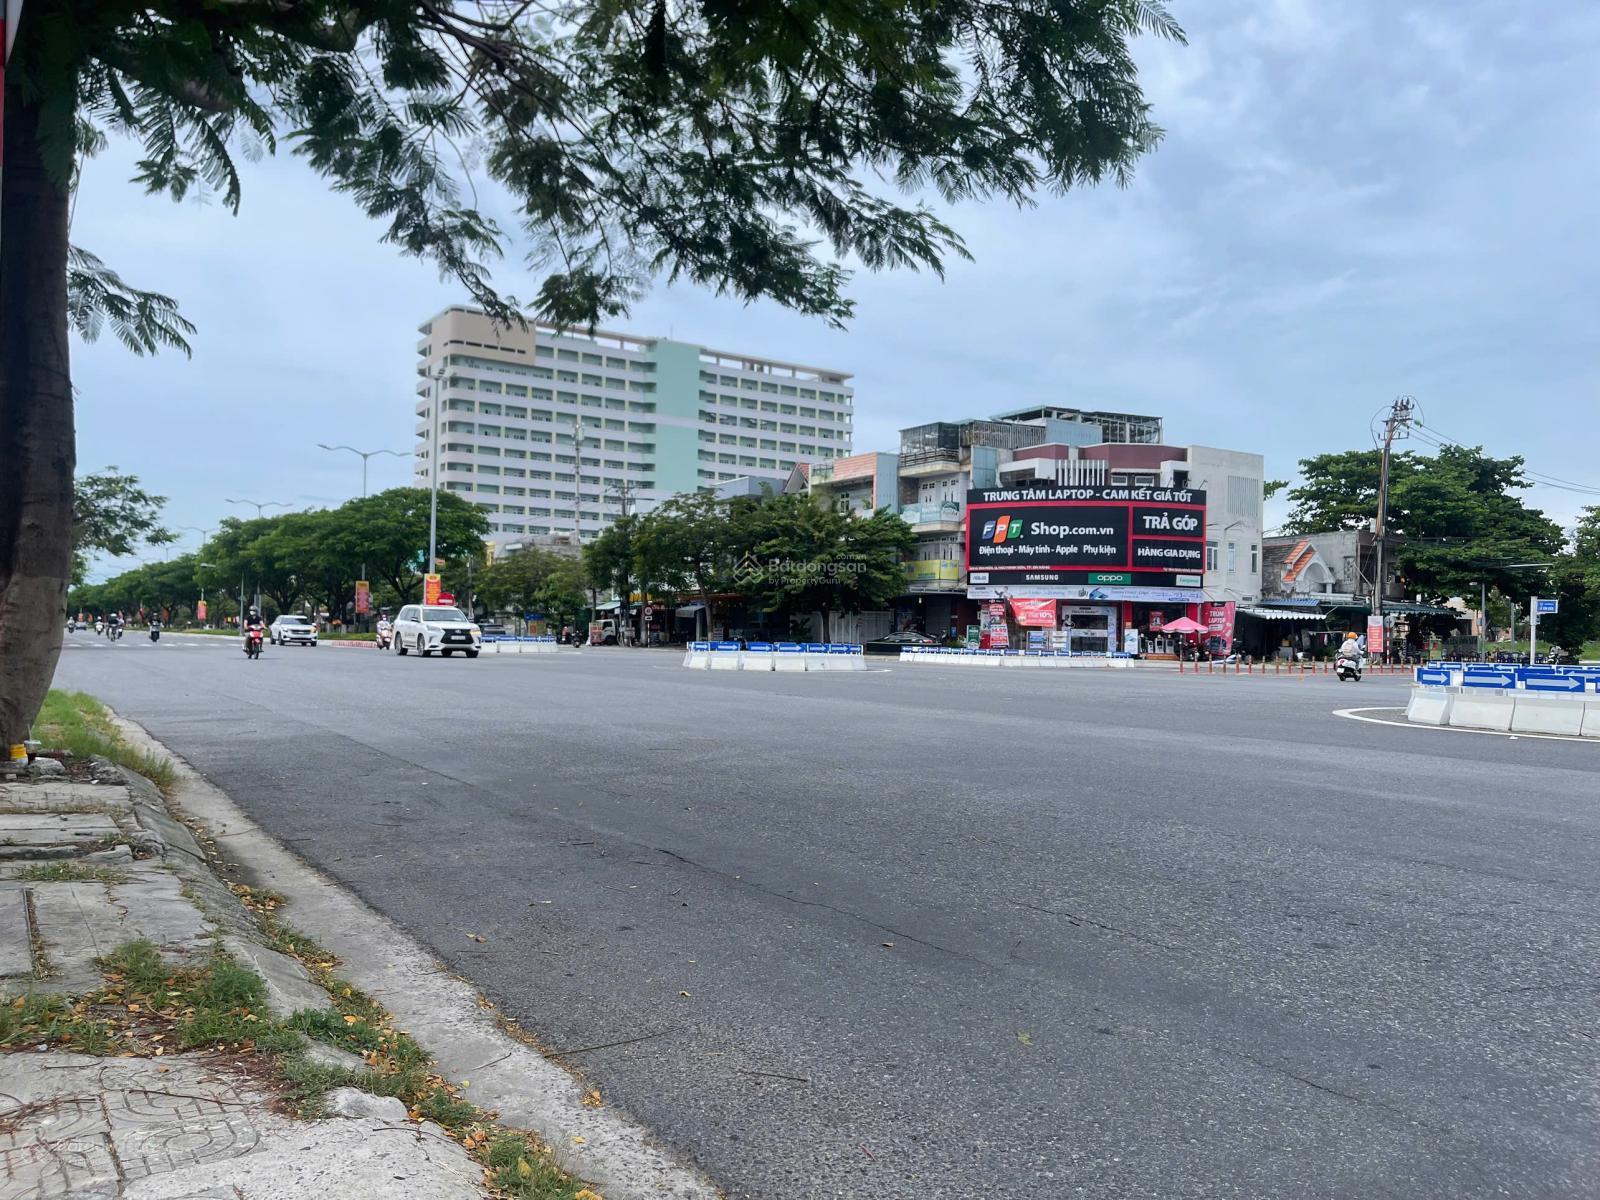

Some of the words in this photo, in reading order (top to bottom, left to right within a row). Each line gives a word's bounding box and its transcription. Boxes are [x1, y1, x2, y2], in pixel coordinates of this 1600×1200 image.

[983, 491, 1020, 502] TRUNG
[1021, 488, 1045, 501] TÂM
[1048, 489, 1093, 500] LAPTOP
[1102, 489, 1129, 500] CAM
[1131, 487, 1152, 500] KẾT
[1153, 489, 1173, 501] GIÁ
[1174, 489, 1193, 502] TỐT
[1143, 512, 1170, 530] TRẢ
[1172, 515, 1198, 531] GÓP
[1031, 522, 1114, 538] Shop.com.vn
[979, 545, 995, 556] Điện
[995, 545, 1014, 556] thoại
[1018, 545, 1034, 556] Máy
[1035, 545, 1050, 554] tính
[1056, 545, 1078, 556] Apple
[1083, 545, 1099, 556] Phụ
[1099, 545, 1117, 556] kiện
[1137, 546, 1163, 558] HÀNG
[1163, 548, 1179, 558] GIA
[1179, 549, 1201, 560] DỤNG
